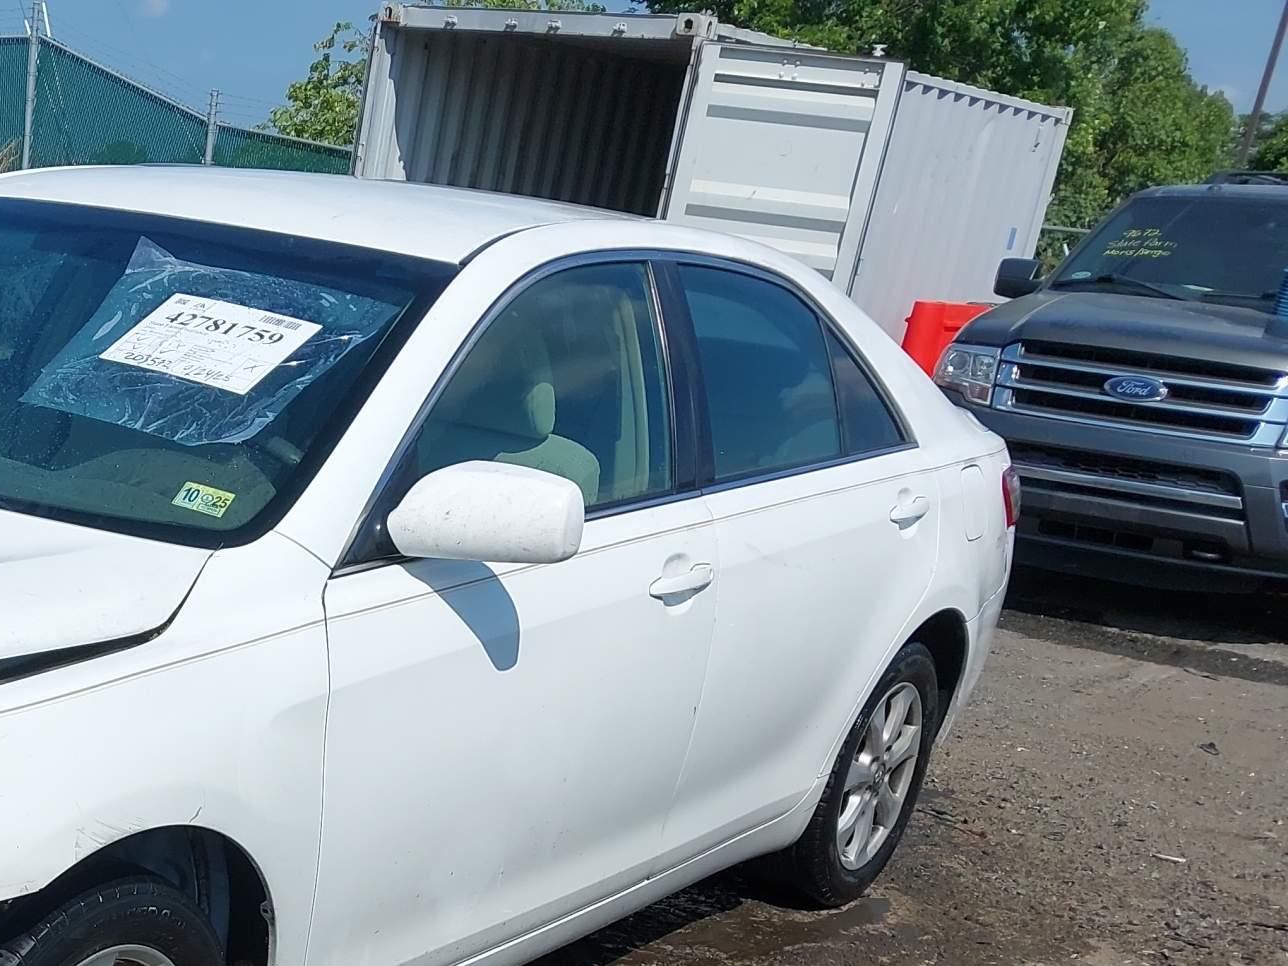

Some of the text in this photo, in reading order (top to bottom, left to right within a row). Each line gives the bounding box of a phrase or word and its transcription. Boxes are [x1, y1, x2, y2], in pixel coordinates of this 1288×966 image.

[165, 311, 284, 345] 42781759
[1116, 380, 1151, 396] Ford
[182, 487, 201, 503] 10
[212, 495, 230, 509] 25
